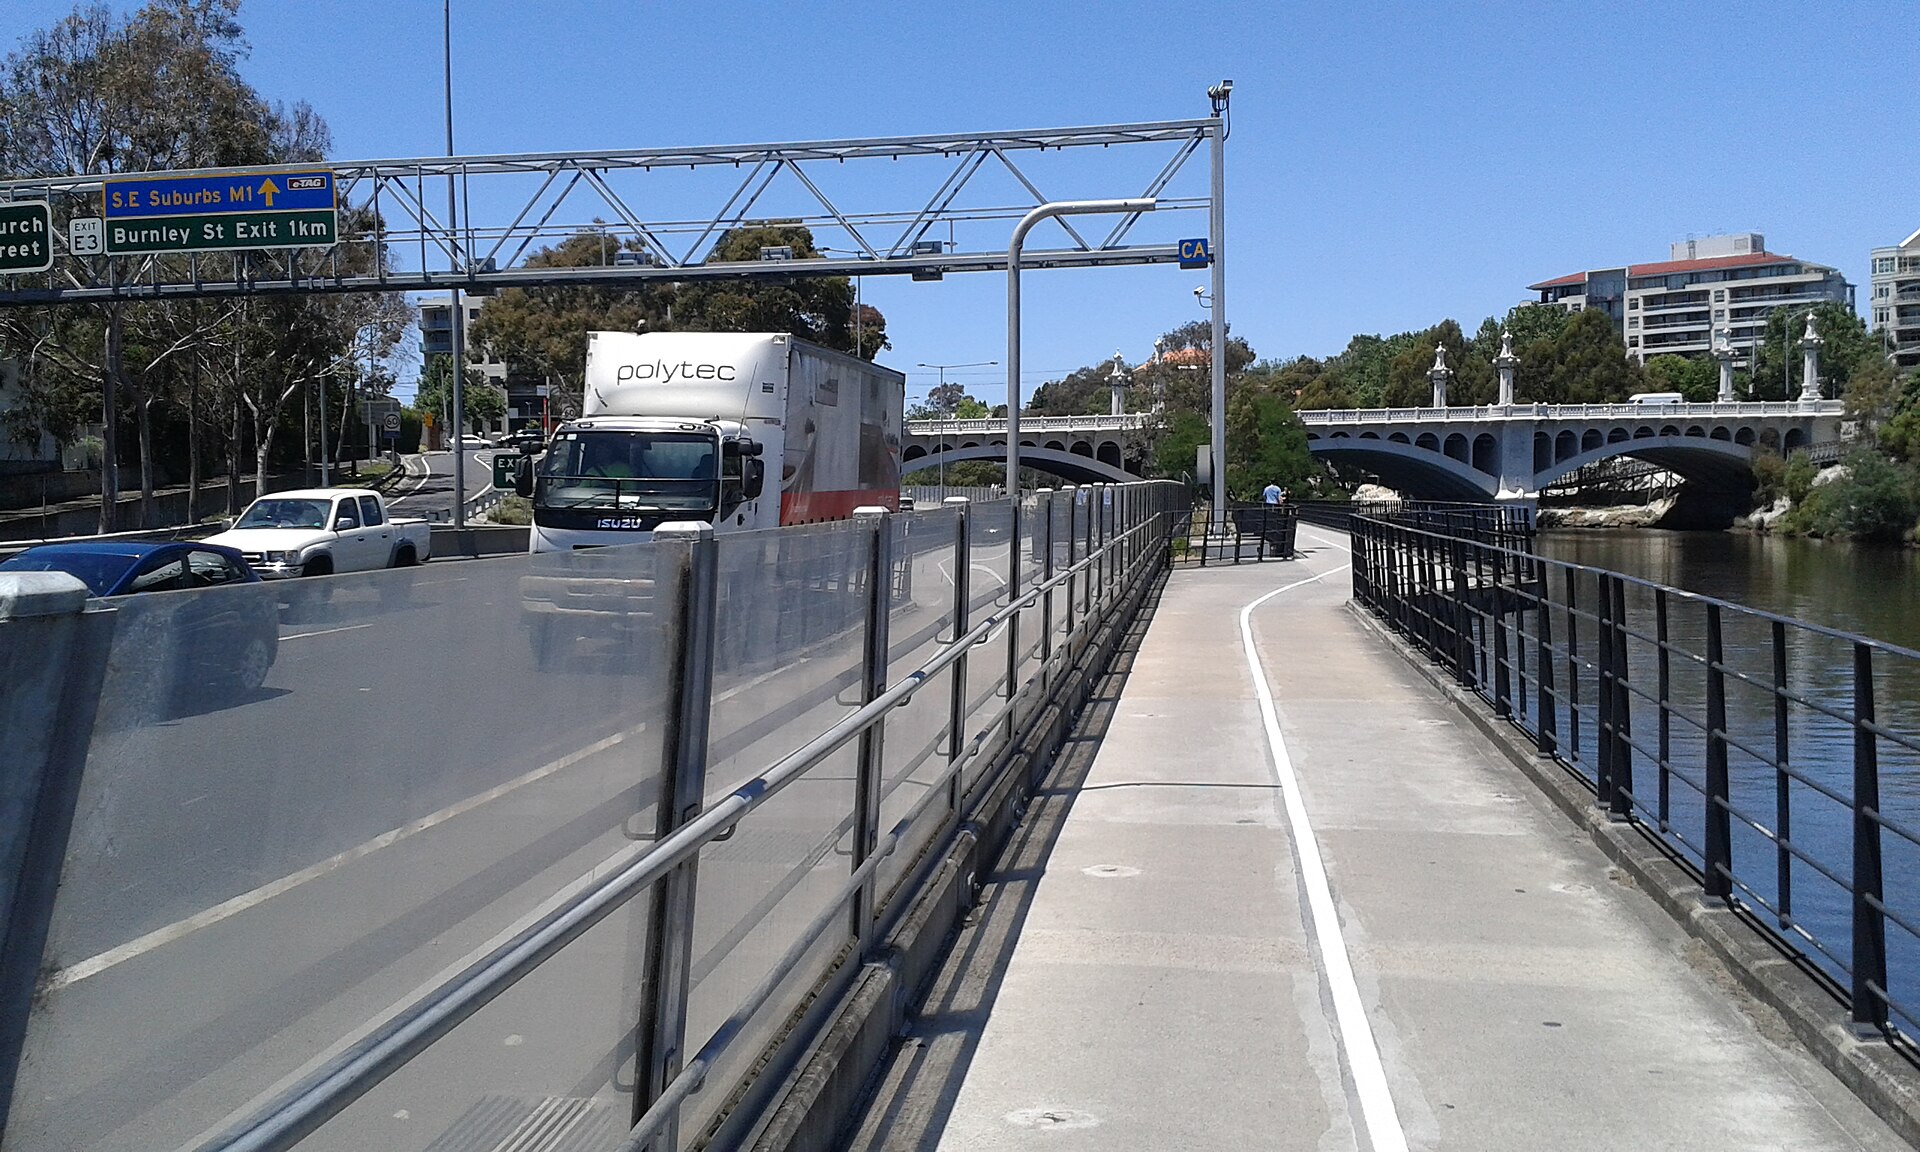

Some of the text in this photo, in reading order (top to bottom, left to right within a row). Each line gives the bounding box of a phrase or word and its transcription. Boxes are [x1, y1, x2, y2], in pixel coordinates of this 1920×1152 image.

[112, 186, 252, 208] S.E Suburbs M1
[75, 222, 96, 231] EXIT
[114, 220, 327, 245] Burnley St Exit 1km
[75, 234, 98, 250] E3
[1181, 242, 1206, 259] CA
[617, 358, 736, 386] polytec
[565, 409, 575, 418] 60
[386, 417, 398, 425] 60
[498, 458, 515, 468] EX
[597, 518, 641, 529] ISUZU
